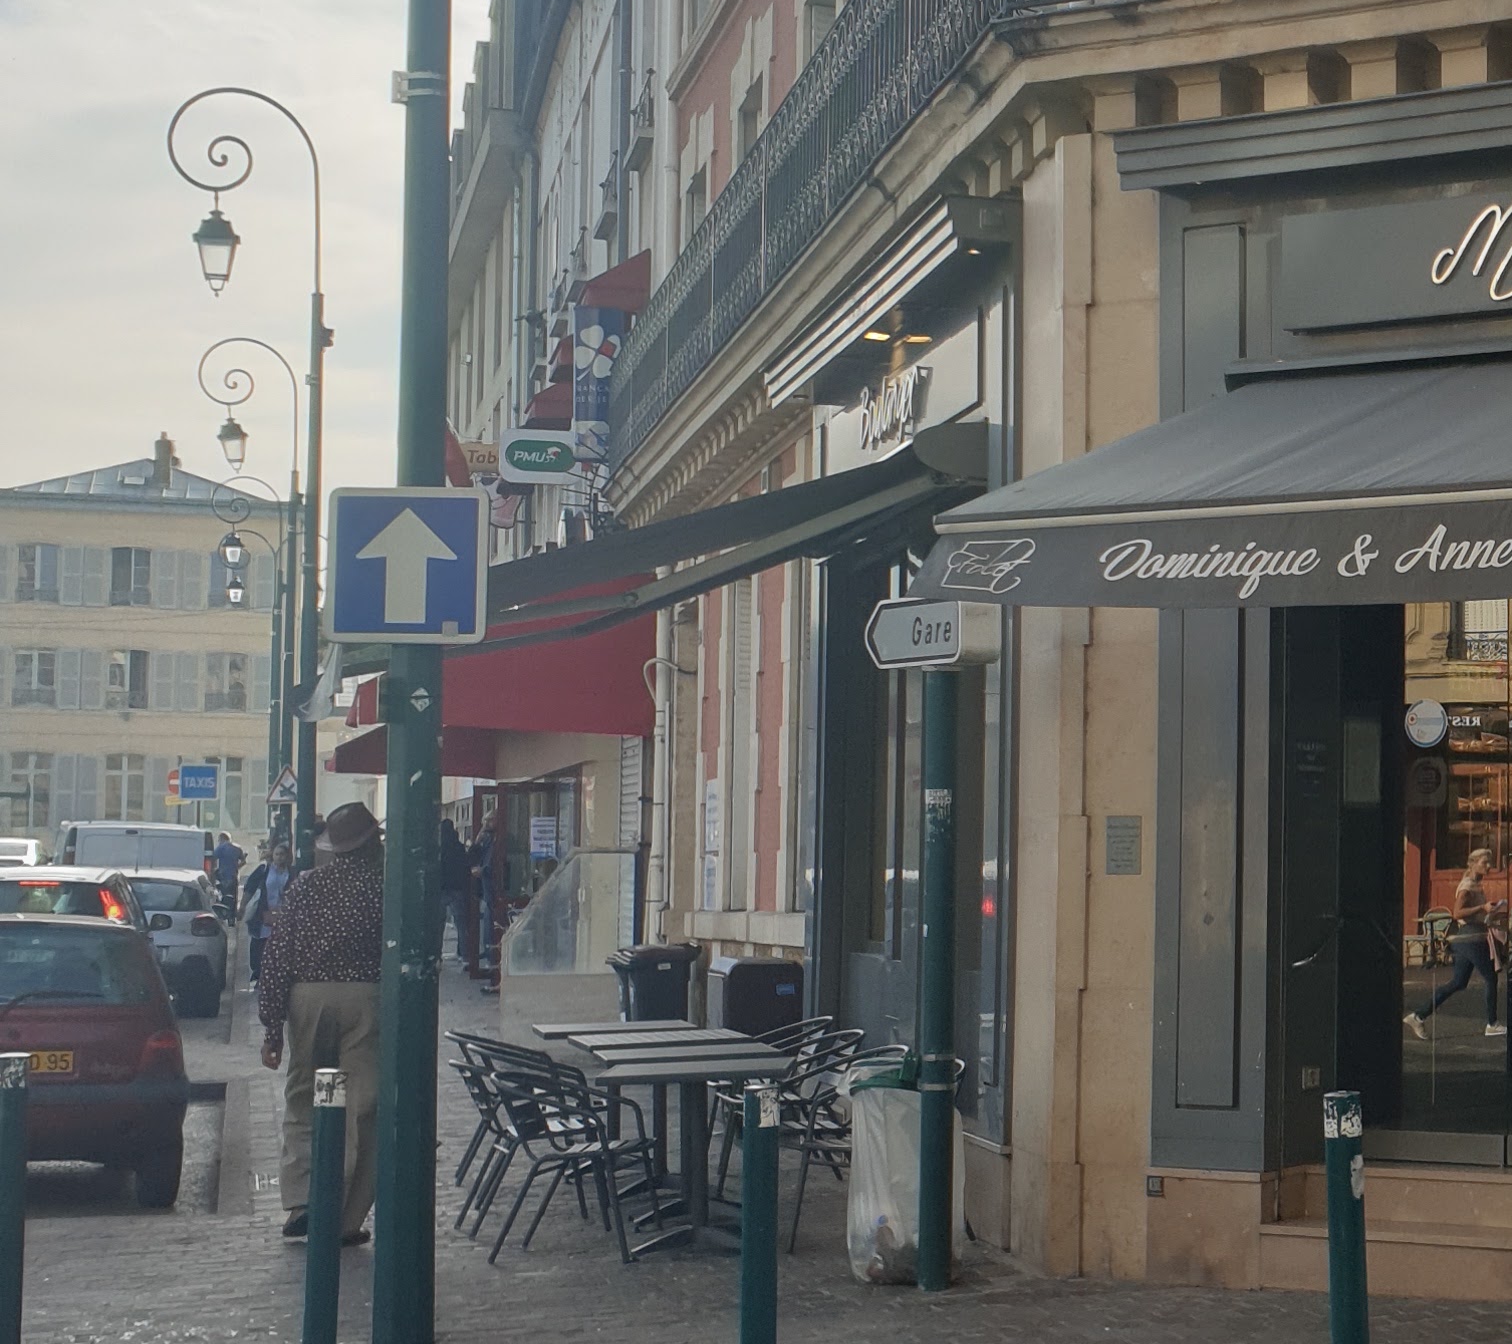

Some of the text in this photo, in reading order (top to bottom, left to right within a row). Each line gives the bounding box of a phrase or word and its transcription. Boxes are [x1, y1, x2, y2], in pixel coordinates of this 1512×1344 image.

[513, 450, 546, 463] PMU
[1100, 538, 1321, 599] Dominique
[1337, 534, 1379, 577] &
[912, 616, 952, 646] Gare
[184, 777, 216, 789] TAXIS
[47, 1054, 71, 1071] 95
